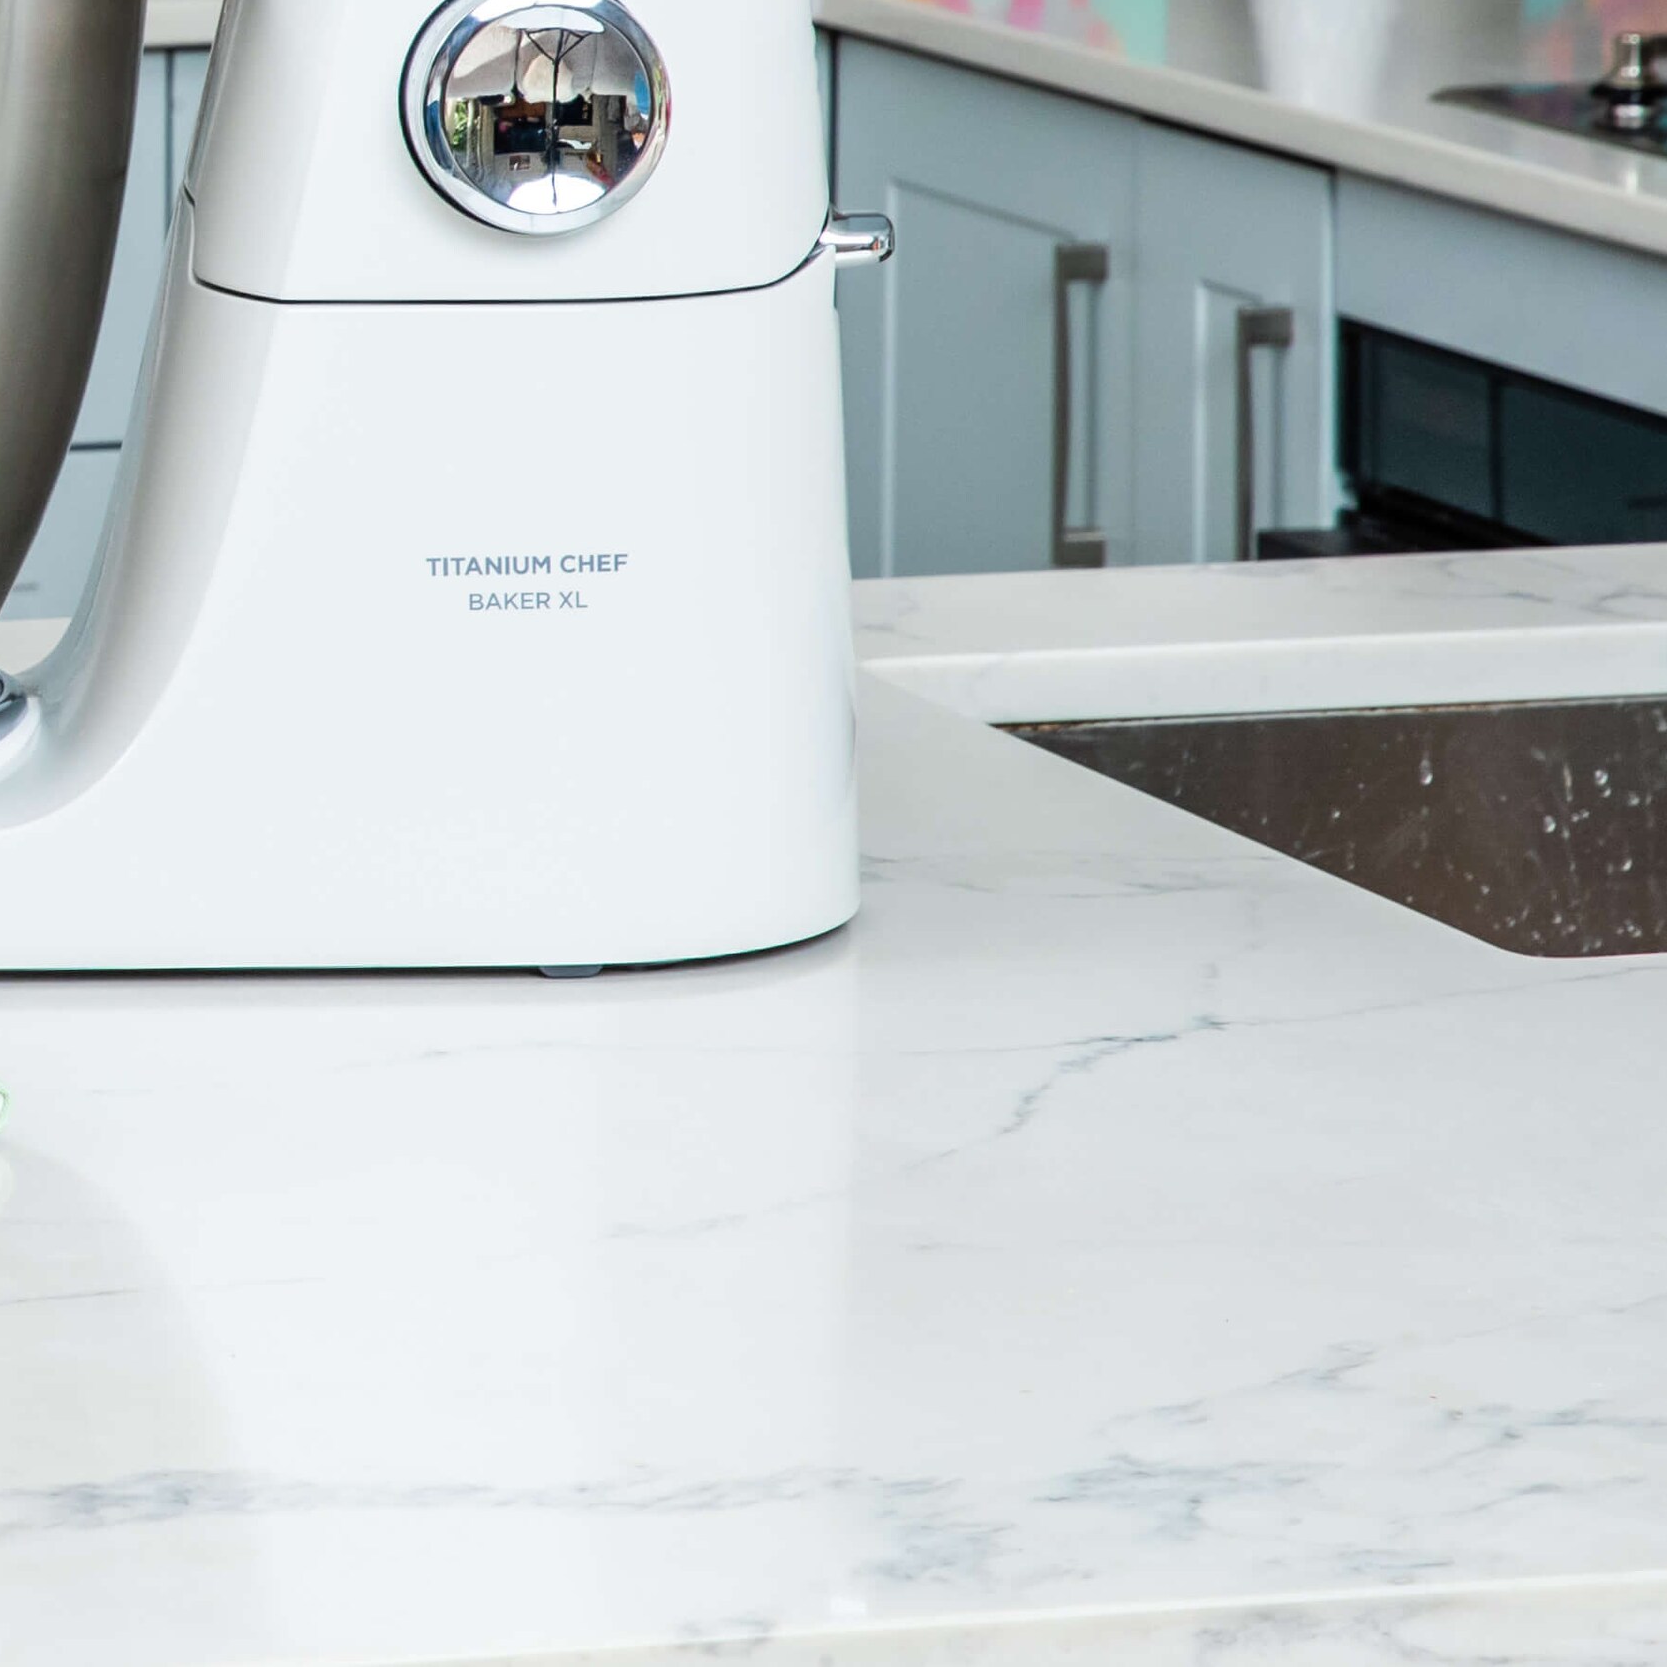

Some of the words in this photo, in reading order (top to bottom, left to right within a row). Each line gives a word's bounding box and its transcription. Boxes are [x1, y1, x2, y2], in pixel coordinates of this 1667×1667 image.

[426, 555, 552, 577] TITANIUM
[560, 553, 628, 573] CHEF
[468, 591, 551, 611] BAKER
[559, 591, 588, 609] XL
